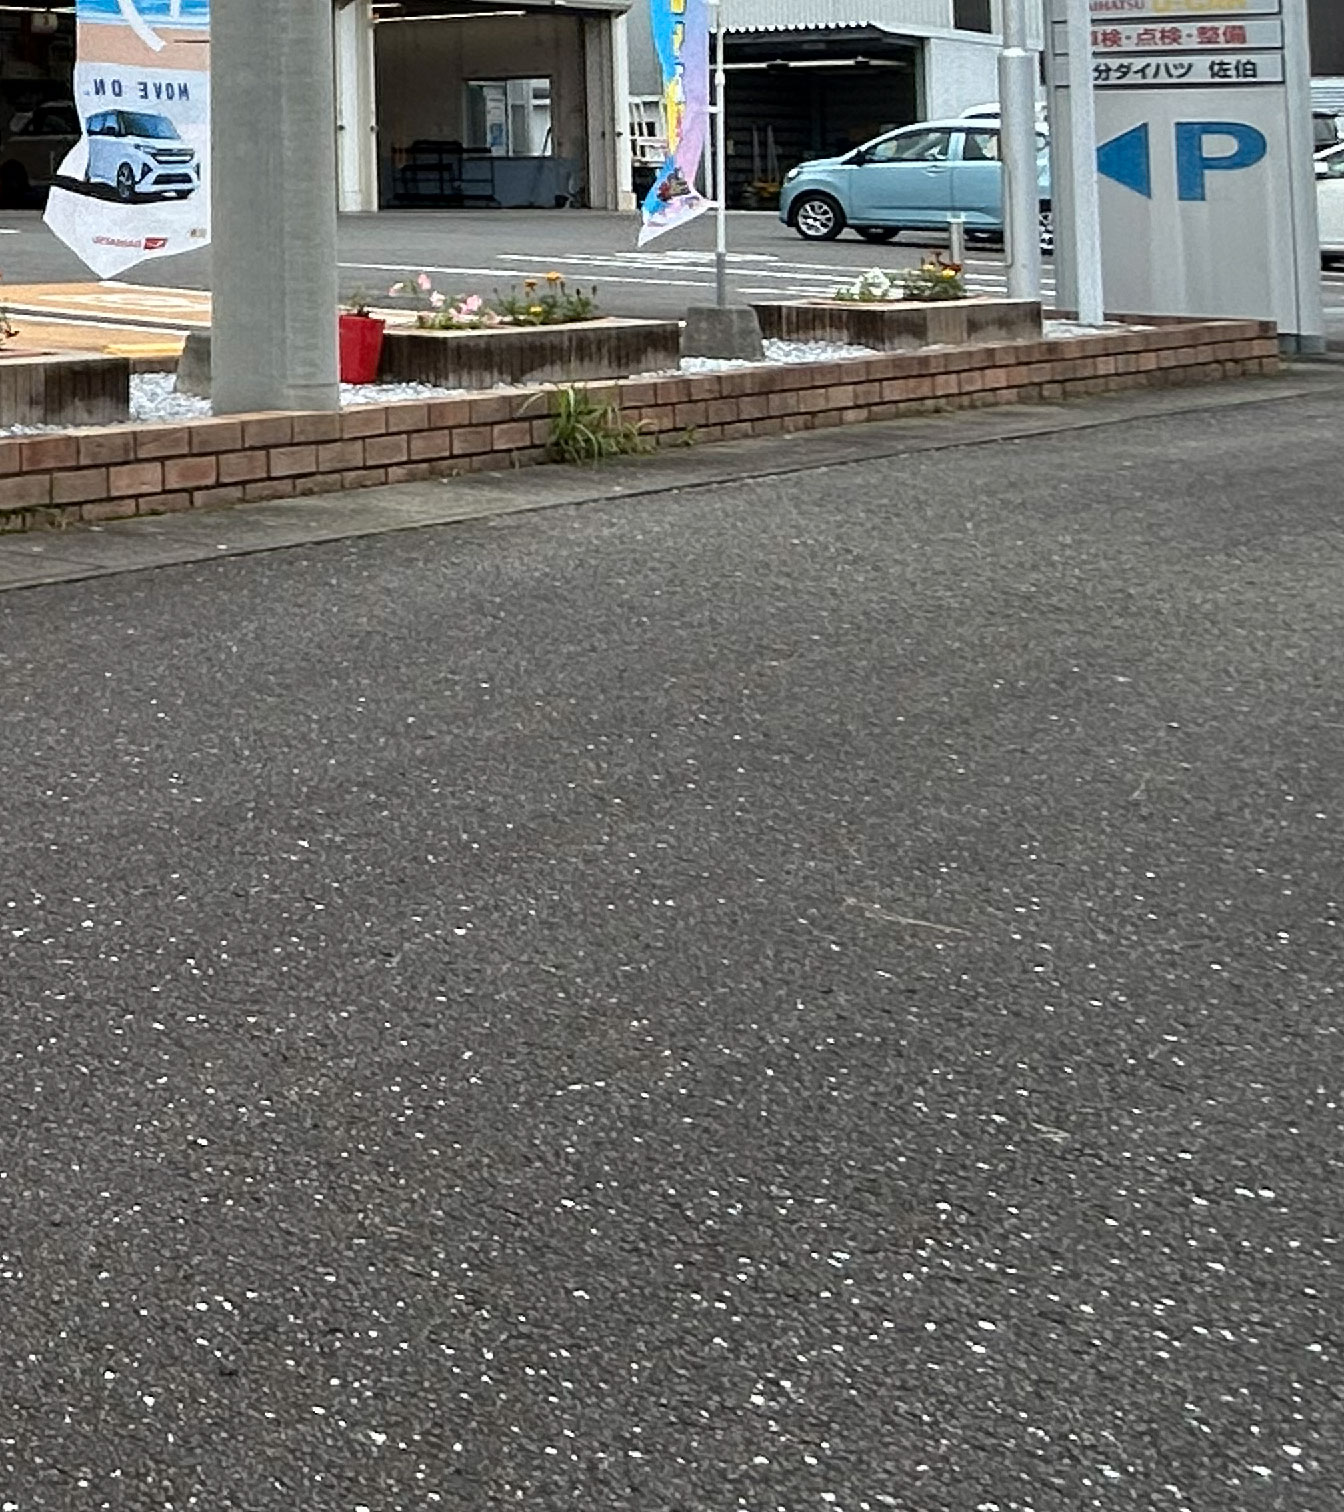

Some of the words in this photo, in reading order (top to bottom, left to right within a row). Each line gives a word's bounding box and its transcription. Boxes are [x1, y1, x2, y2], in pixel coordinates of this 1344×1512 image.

[1090, 24, 1247, 48] 検・点検・整備
[1208, 59, 1258, 80] 佐伯
[1174, 121, 1268, 201] P
